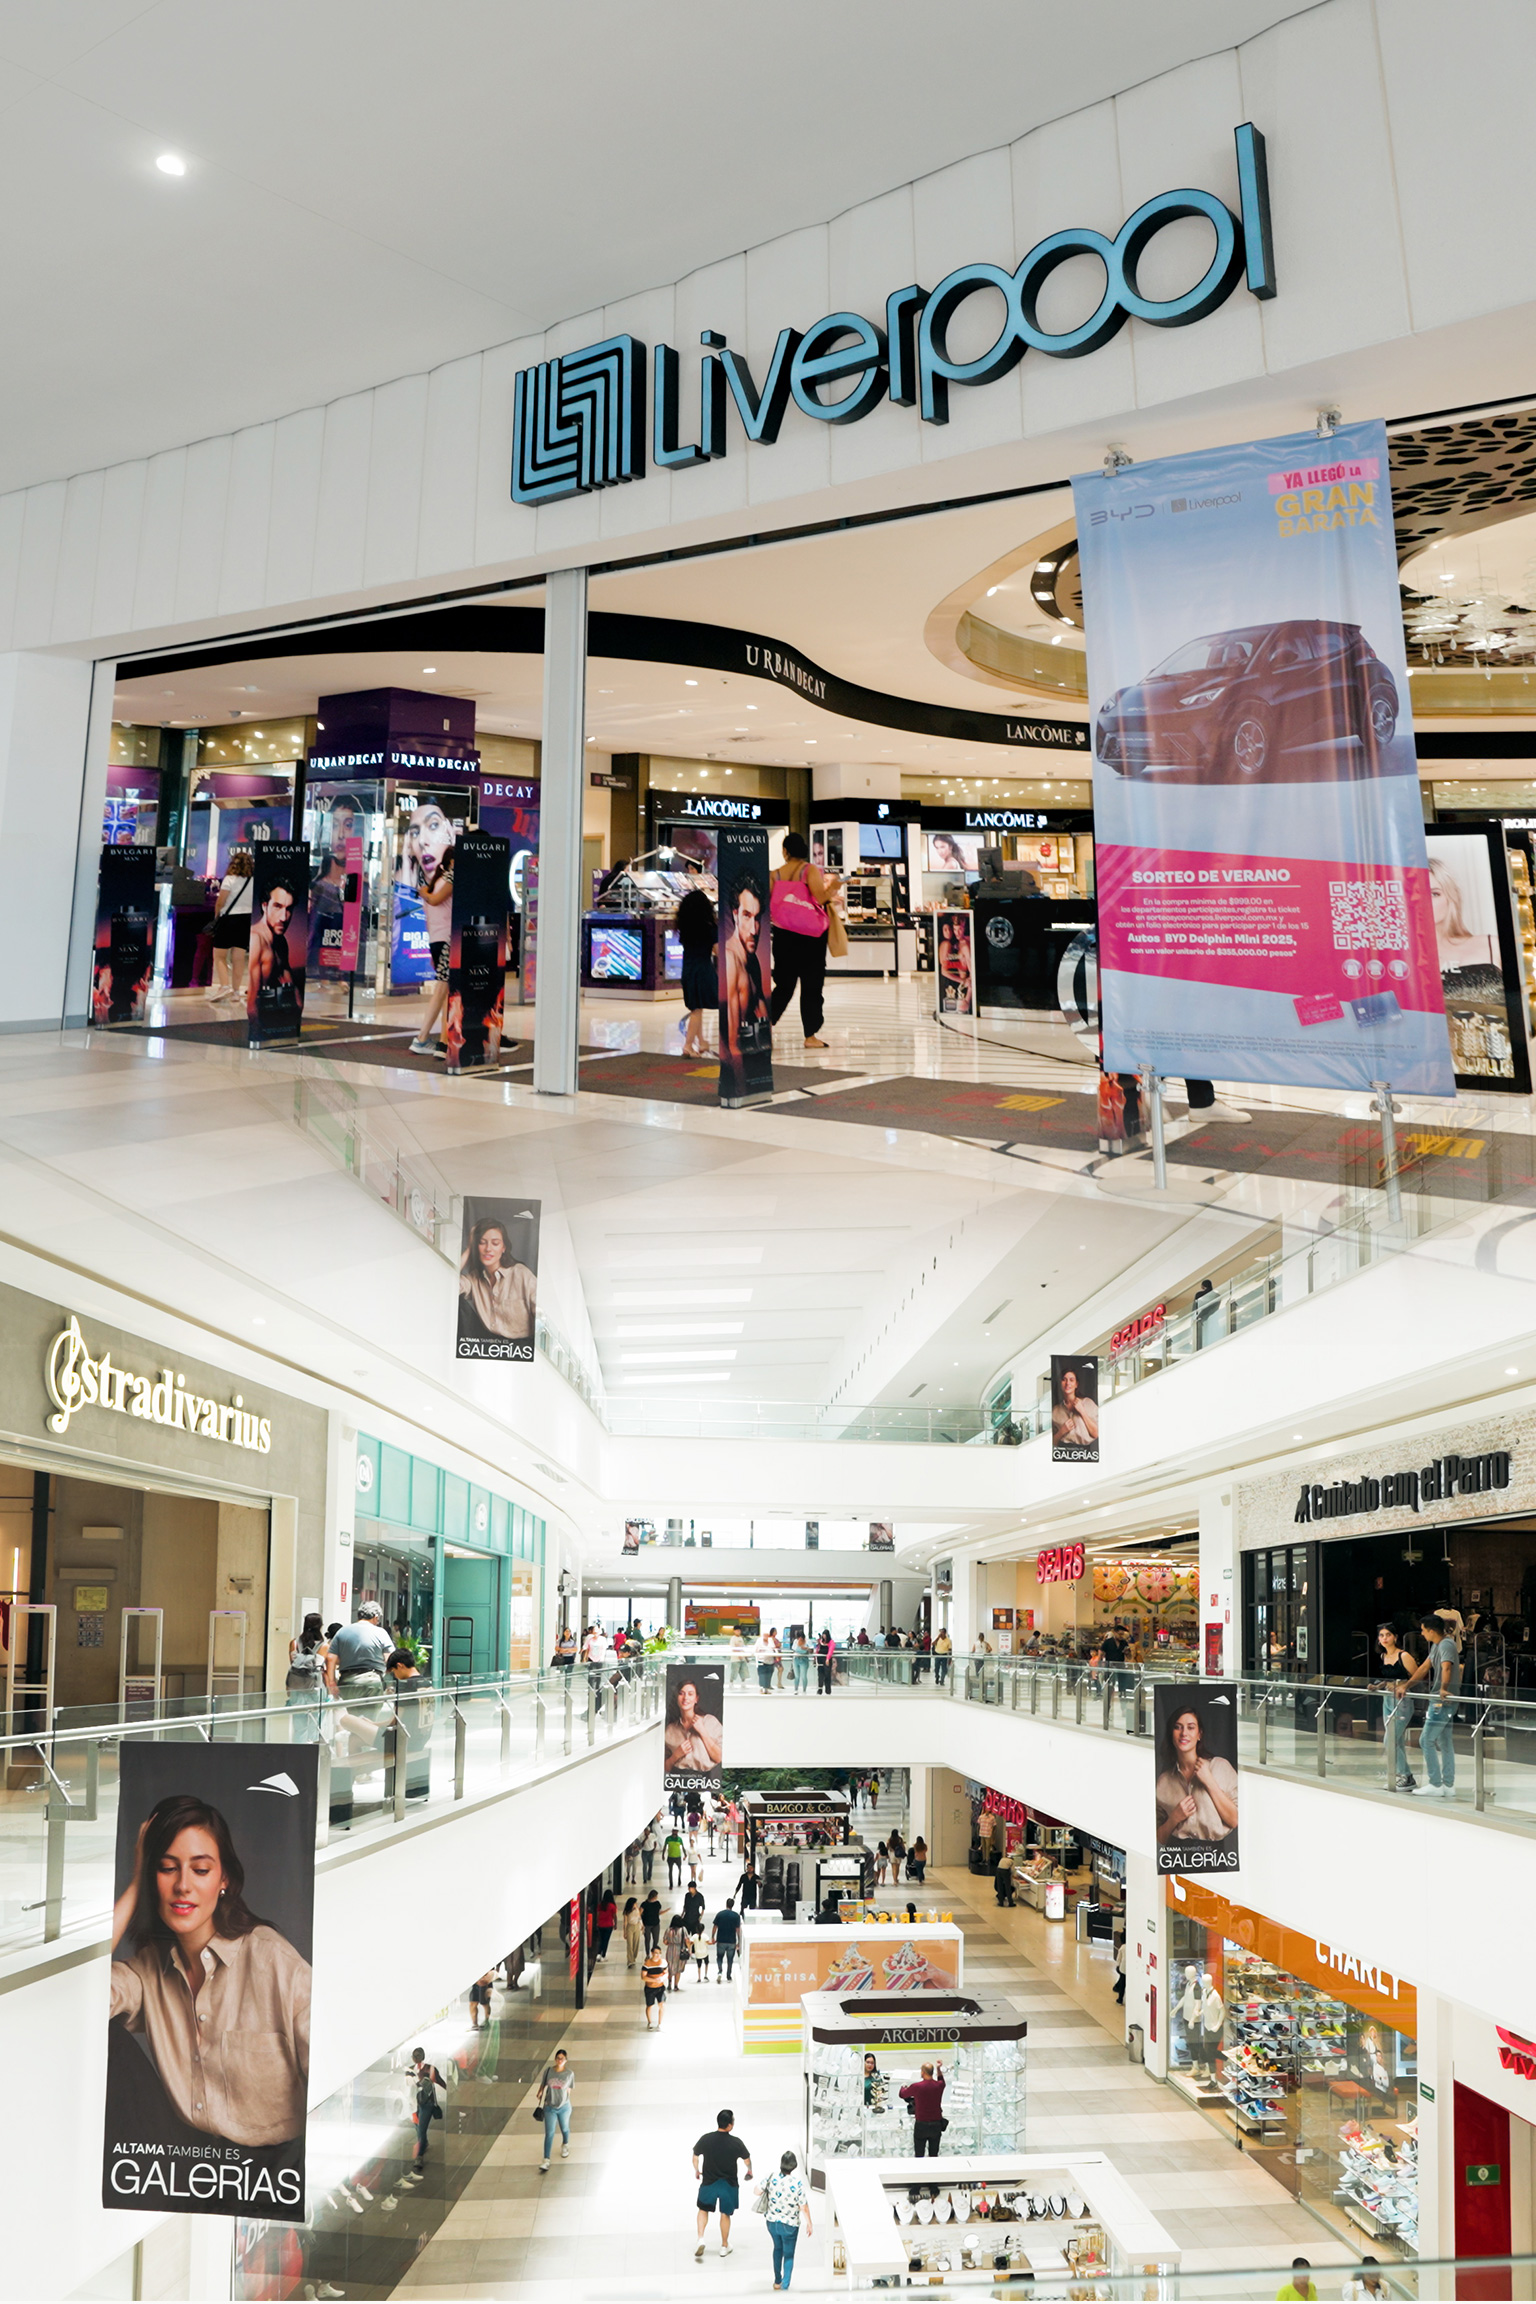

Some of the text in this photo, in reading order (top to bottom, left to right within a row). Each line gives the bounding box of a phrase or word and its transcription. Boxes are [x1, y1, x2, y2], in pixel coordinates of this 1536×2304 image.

[654, 122, 1277, 470] Liverpool
[1283, 464, 1362, 489] YA LLEGÓ LA
[1189, 492, 1242, 511] Liverpool
[1275, 482, 1375, 518] GRAN
[1090, 504, 1155, 526] BYD
[1279, 508, 1378, 538] BARATA
[1006, 723, 1072, 744] LANCÔME
[310, 752, 384, 770] URBAN DECAY
[391, 752, 477, 772] URBAN DECAY
[484, 783, 534, 798] DECAY
[965, 811, 1035, 828] LANCÔME
[463, 842, 505, 852] BVLGARI
[727, 834, 766, 844] BVLGARI
[110, 848, 152, 856] BVLGARI
[262, 845, 305, 854] BVLGARI
[1132, 868, 1291, 883] SORTEO DE VERANO
[1128, 933, 1297, 946] Autos BYD Dolphin Mini 2025,
[1110, 1303, 1167, 1353] SEARS
[1311, 1475, 1380, 1520] Cuidado
[1421, 1458, 1443, 1501] el
[1443, 1450, 1510, 1497] Perro
[1036, 1542, 1086, 1584] SEARS
[806, 1804, 815, 1813] &
[818, 1804, 833, 1813] Co.
[754, 1972, 817, 1982] NUTRISA
[880, 2028, 960, 2043] ARGENTO
[112, 2142, 240, 2160] ALTAMA TAMBIÉN ES
